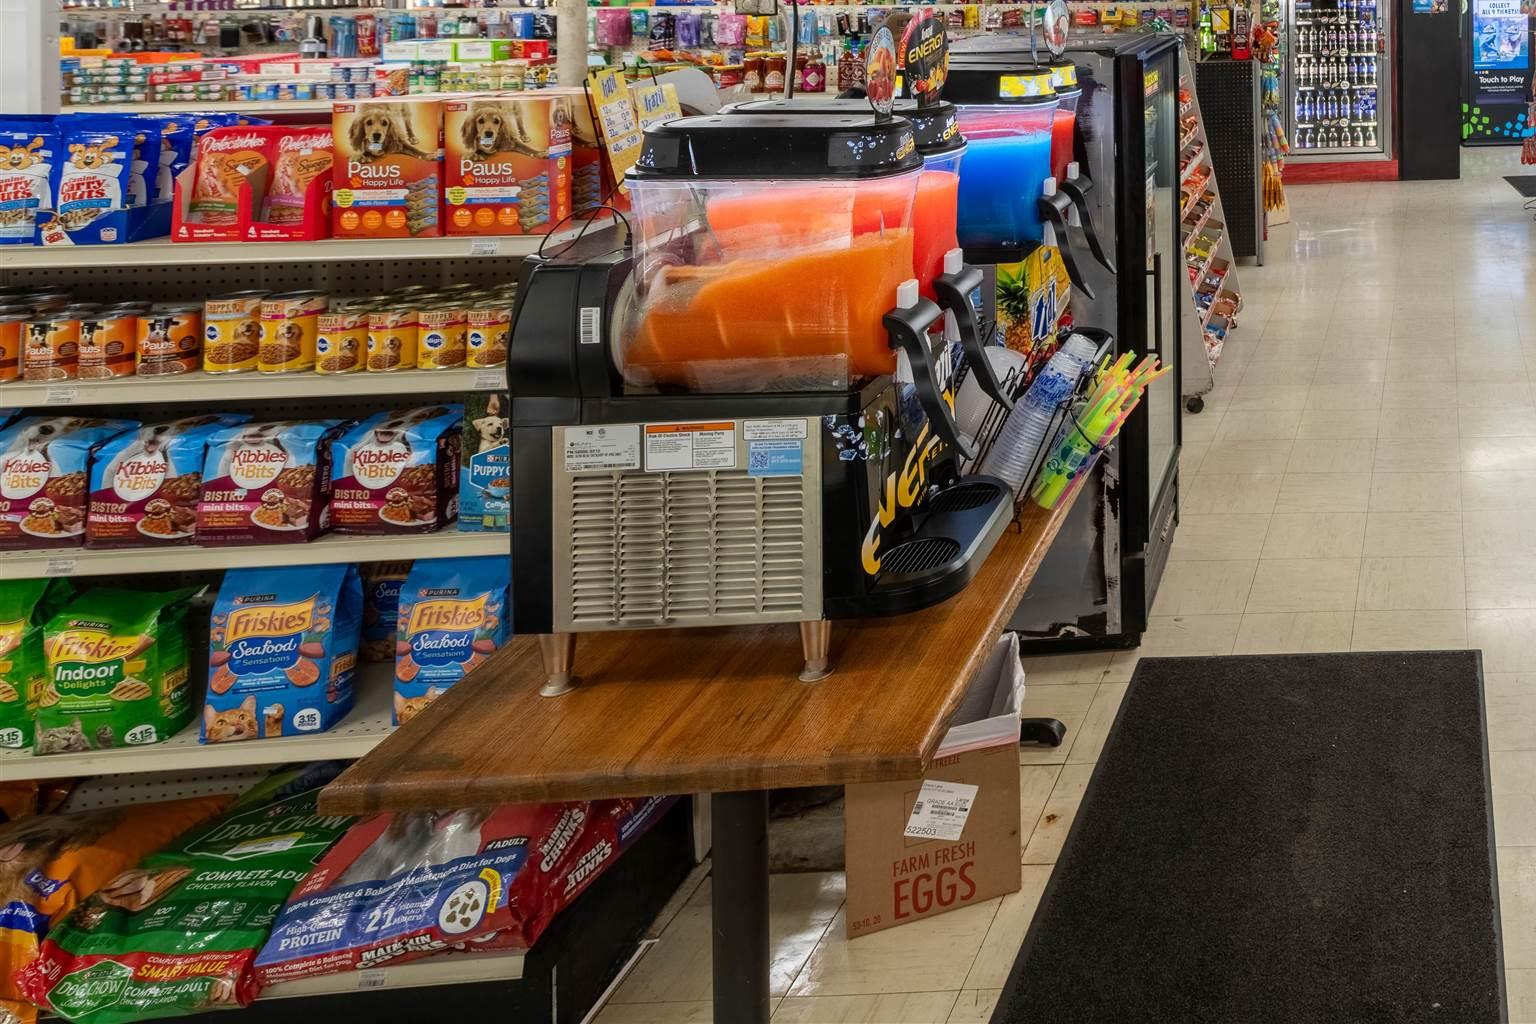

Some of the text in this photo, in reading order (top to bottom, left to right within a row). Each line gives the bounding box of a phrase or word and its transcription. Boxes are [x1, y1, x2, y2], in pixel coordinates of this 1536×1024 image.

[908, 32, 945, 64] ENERGY
[1509, 76, 1524, 84] Play
[644, 88, 664, 112] frazil
[550, 128, 571, 140] Paws
[201, 135, 266, 154] Delectables
[348, 160, 400, 178] Paws
[460, 159, 512, 177] Paws
[61, 178, 104, 195] Carry
[362, 178, 404, 188] Happy Life
[475, 175, 516, 186] Happy Life
[143, 341, 175, 351] Paws
[232, 450, 288, 465] Kibbles
[352, 450, 410, 465] Kibbles
[116, 459, 167, 477] Kibbles
[245, 466, 275, 478] Bits
[367, 465, 397, 478] Bits
[473, 464, 503, 476] PUPPY
[132, 476, 157, 489] Bits
[203, 490, 244, 502] BISTRO
[334, 489, 370, 500] BISTRO
[90, 502, 127, 513] BISTRO
[334, 501, 372, 510] mini bits
[90, 514, 128, 523] mini bits
[243, 595, 275, 603] PURINA
[232, 610, 307, 632] Friskies
[416, 605, 482, 627] Friskies
[78, 621, 112, 629] PURINA
[232, 638, 297, 660] Seafood
[413, 633, 470, 653] Seafood
[242, 654, 291, 666] Sensations
[422, 649, 465, 659] Sensations
[56, 664, 118, 681] Indoor
[63, 679, 106, 690] Delights
[298, 714, 317, 724] 3.15
[129, 728, 152, 743] 3.15
[207, 811, 349, 842] DOG CHOW
[906, 825, 937, 836] 522503
[498, 837, 528, 849] ADULT
[540, 808, 586, 873] CHUNKS
[459, 852, 517, 873] Diet for Dogs
[893, 841, 975, 878] FARM FRESH
[196, 869, 268, 882] COMPLETE
[186, 879, 277, 891] CHICKEN FLAVOR
[894, 861, 977, 921] EGGS
[286, 890, 353, 915] 100% Complete
[280, 928, 342, 952] PROTEIN
[56, 979, 121, 996] DOG CHOW
[174, 981, 210, 994] ADULT
